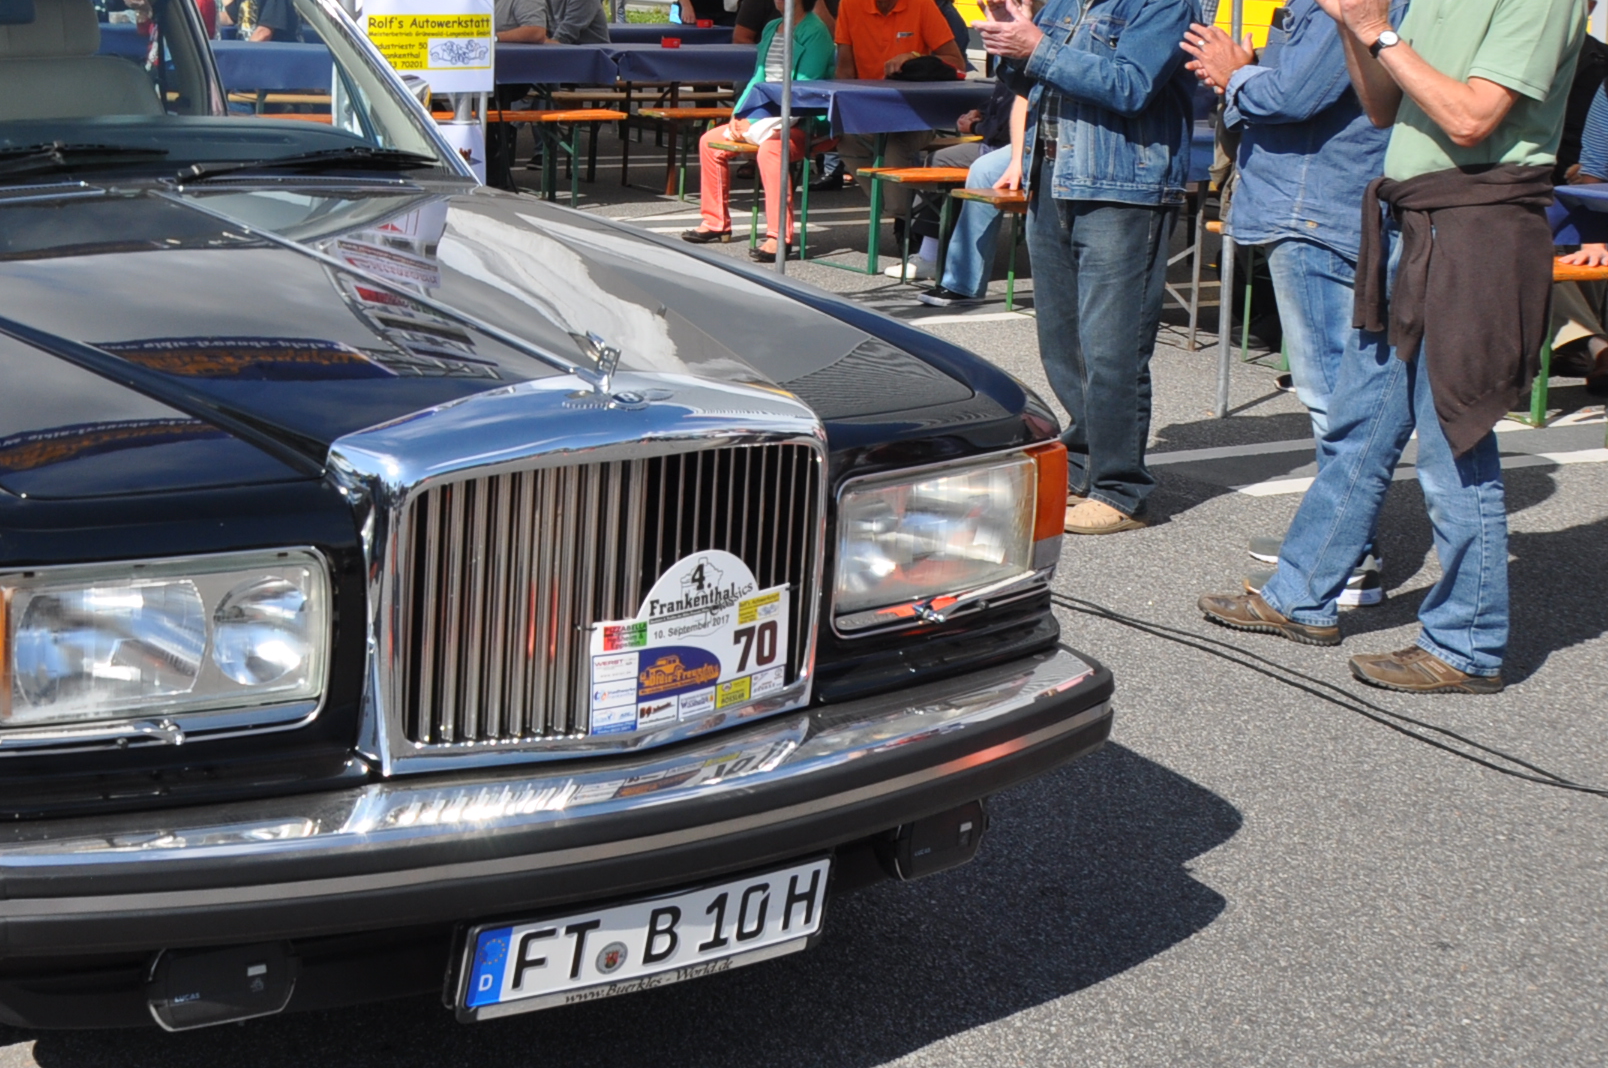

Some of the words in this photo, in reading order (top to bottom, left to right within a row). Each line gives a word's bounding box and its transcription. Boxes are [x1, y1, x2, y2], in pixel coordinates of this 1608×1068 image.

[368, 17, 404, 29] Rolf's
[410, 17, 491, 29] Autowerkstatt
[691, 563, 712, 591] 4.
[649, 582, 735, 617] Frankenthal
[654, 629, 666, 640] 10.
[668, 620, 710, 636] September
[712, 614, 730, 627] 2017
[733, 619, 778, 674] 70
[511, 918, 602, 990] FT
[642, 905, 682, 967] B
[478, 974, 493, 992] D
